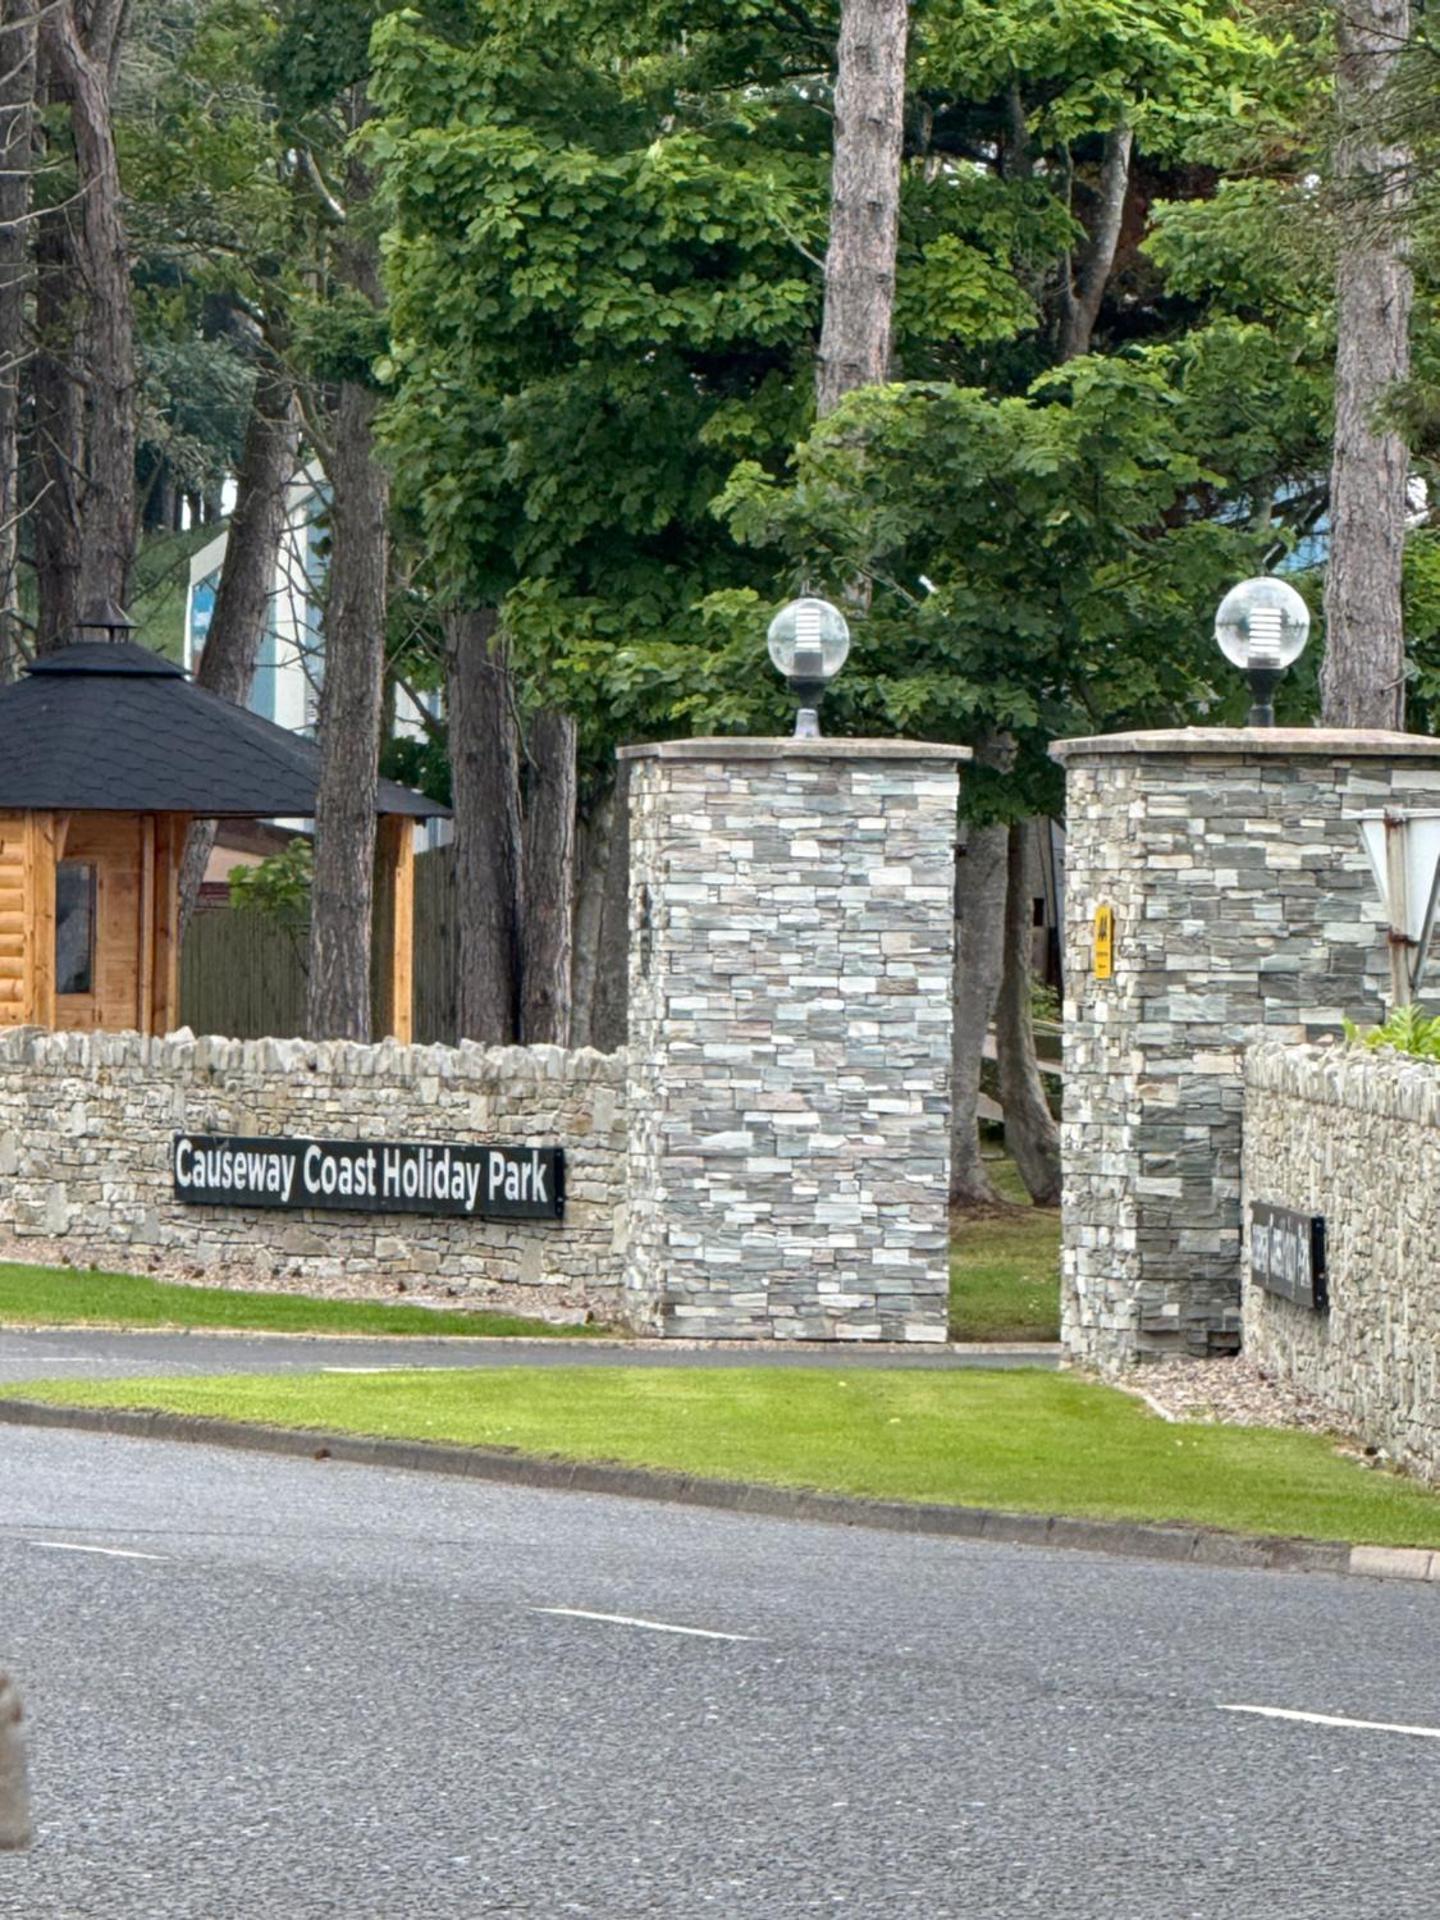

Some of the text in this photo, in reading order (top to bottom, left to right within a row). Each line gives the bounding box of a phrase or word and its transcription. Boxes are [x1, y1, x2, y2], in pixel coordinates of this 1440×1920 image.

[174, 1137, 548, 1210] Causeway Coast Holiday Park
